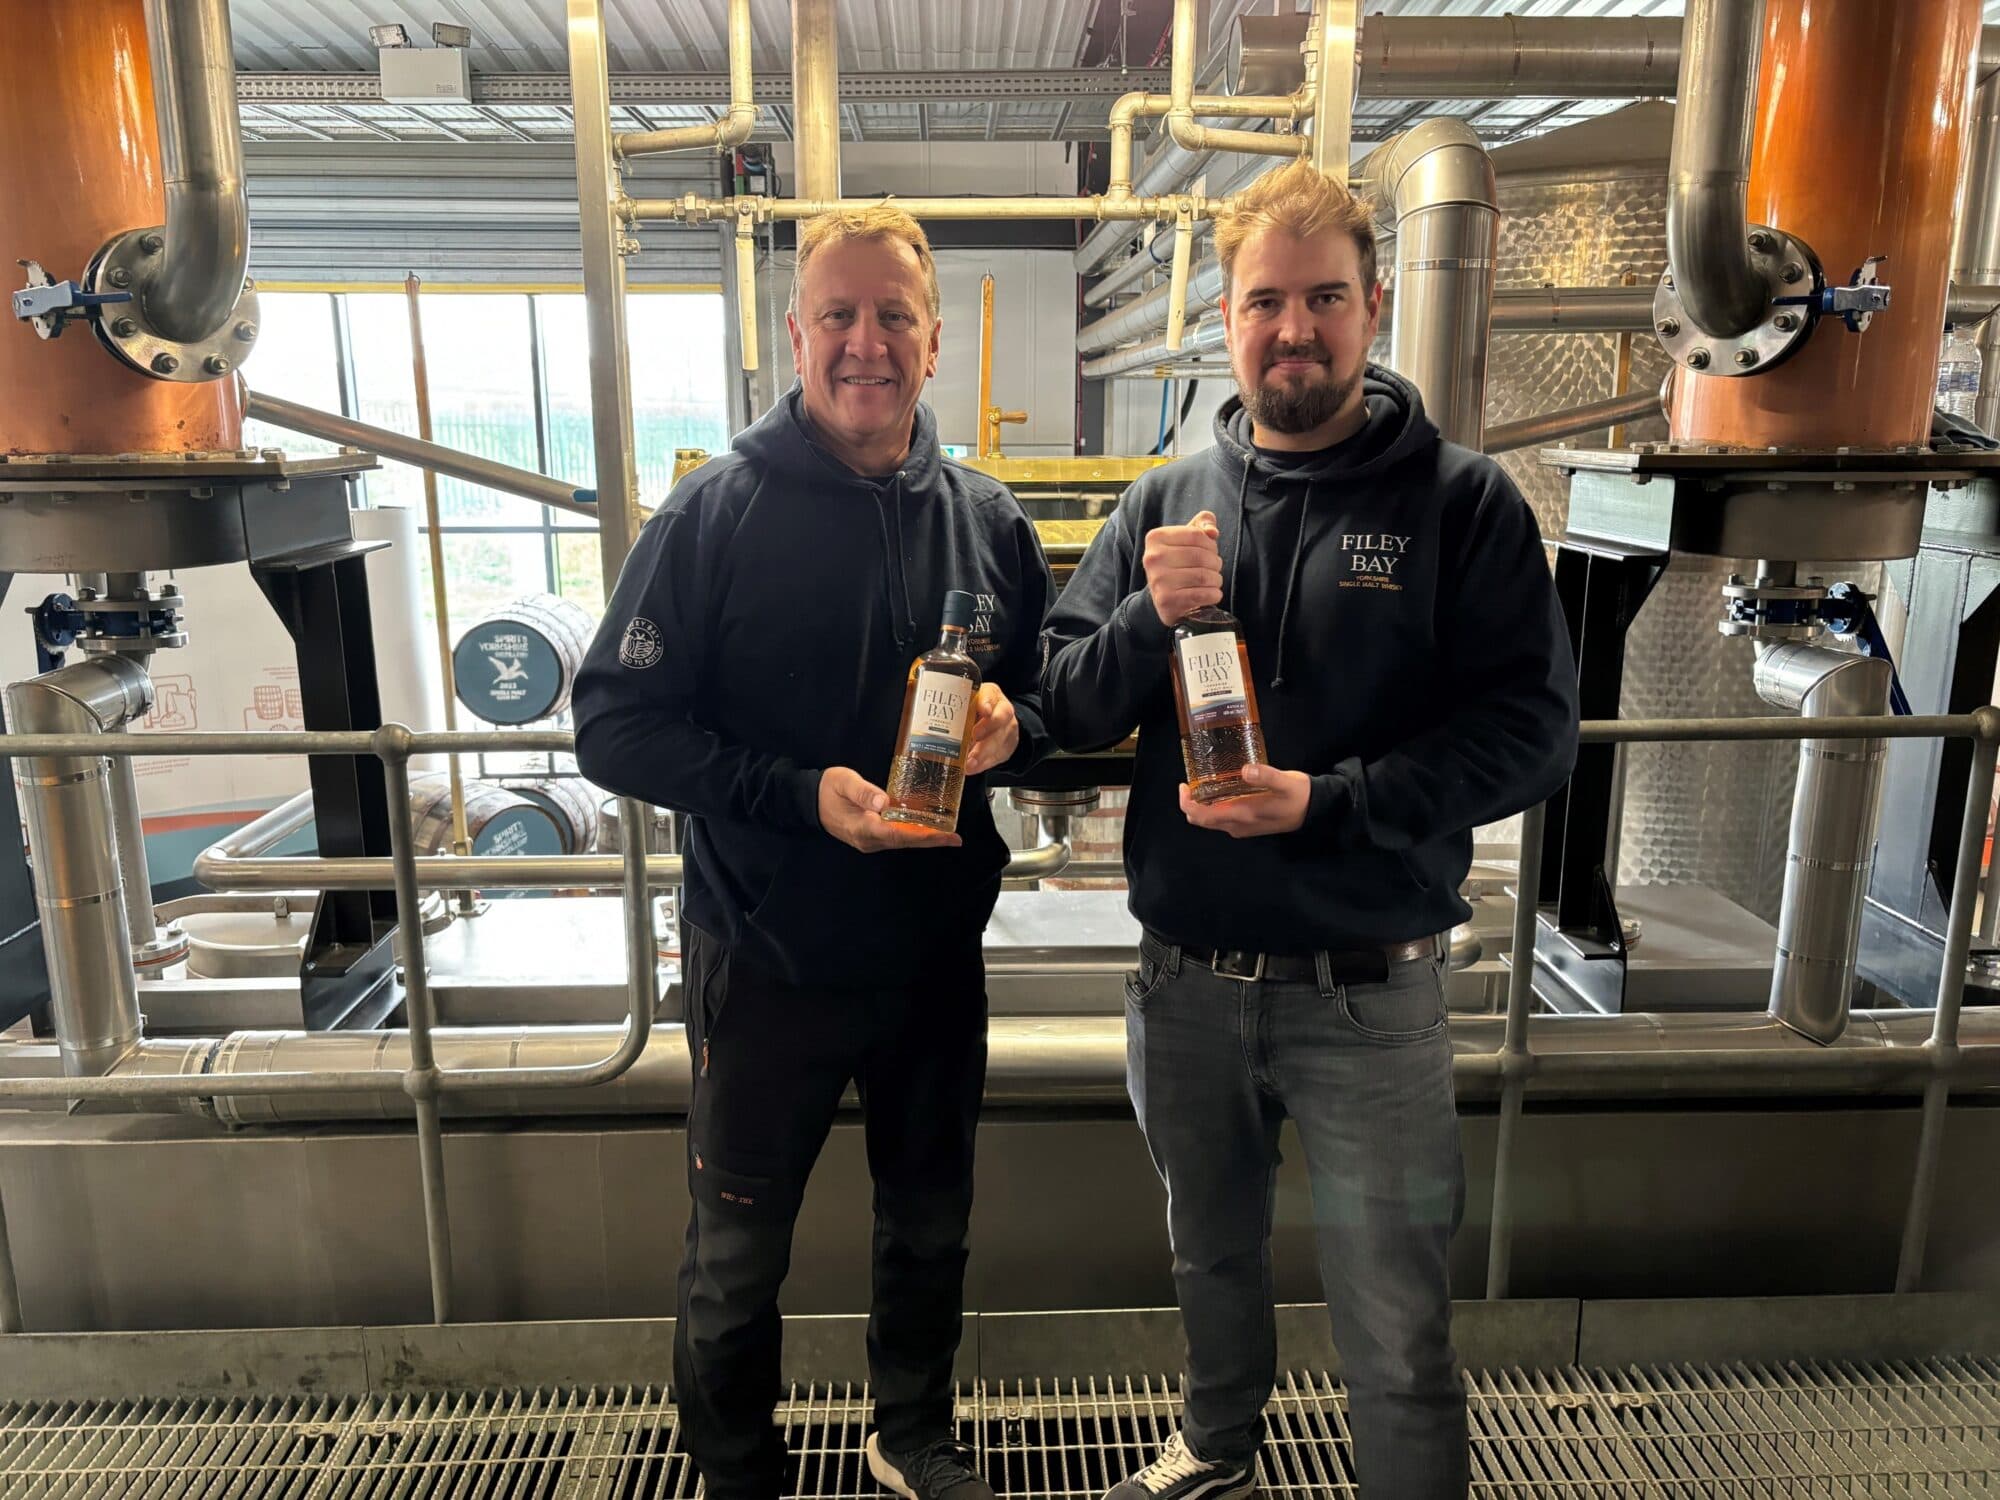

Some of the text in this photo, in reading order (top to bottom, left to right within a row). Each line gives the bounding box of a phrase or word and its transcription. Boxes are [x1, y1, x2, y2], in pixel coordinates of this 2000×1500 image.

[1340, 534, 1411, 553] FILEY
[1350, 554, 1398, 575] BAY
[1187, 651, 1233, 671] FILEY
[1198, 666, 1229, 684] BAY
[923, 689, 967, 710] FILEY
[927, 703, 954, 721] BAY
